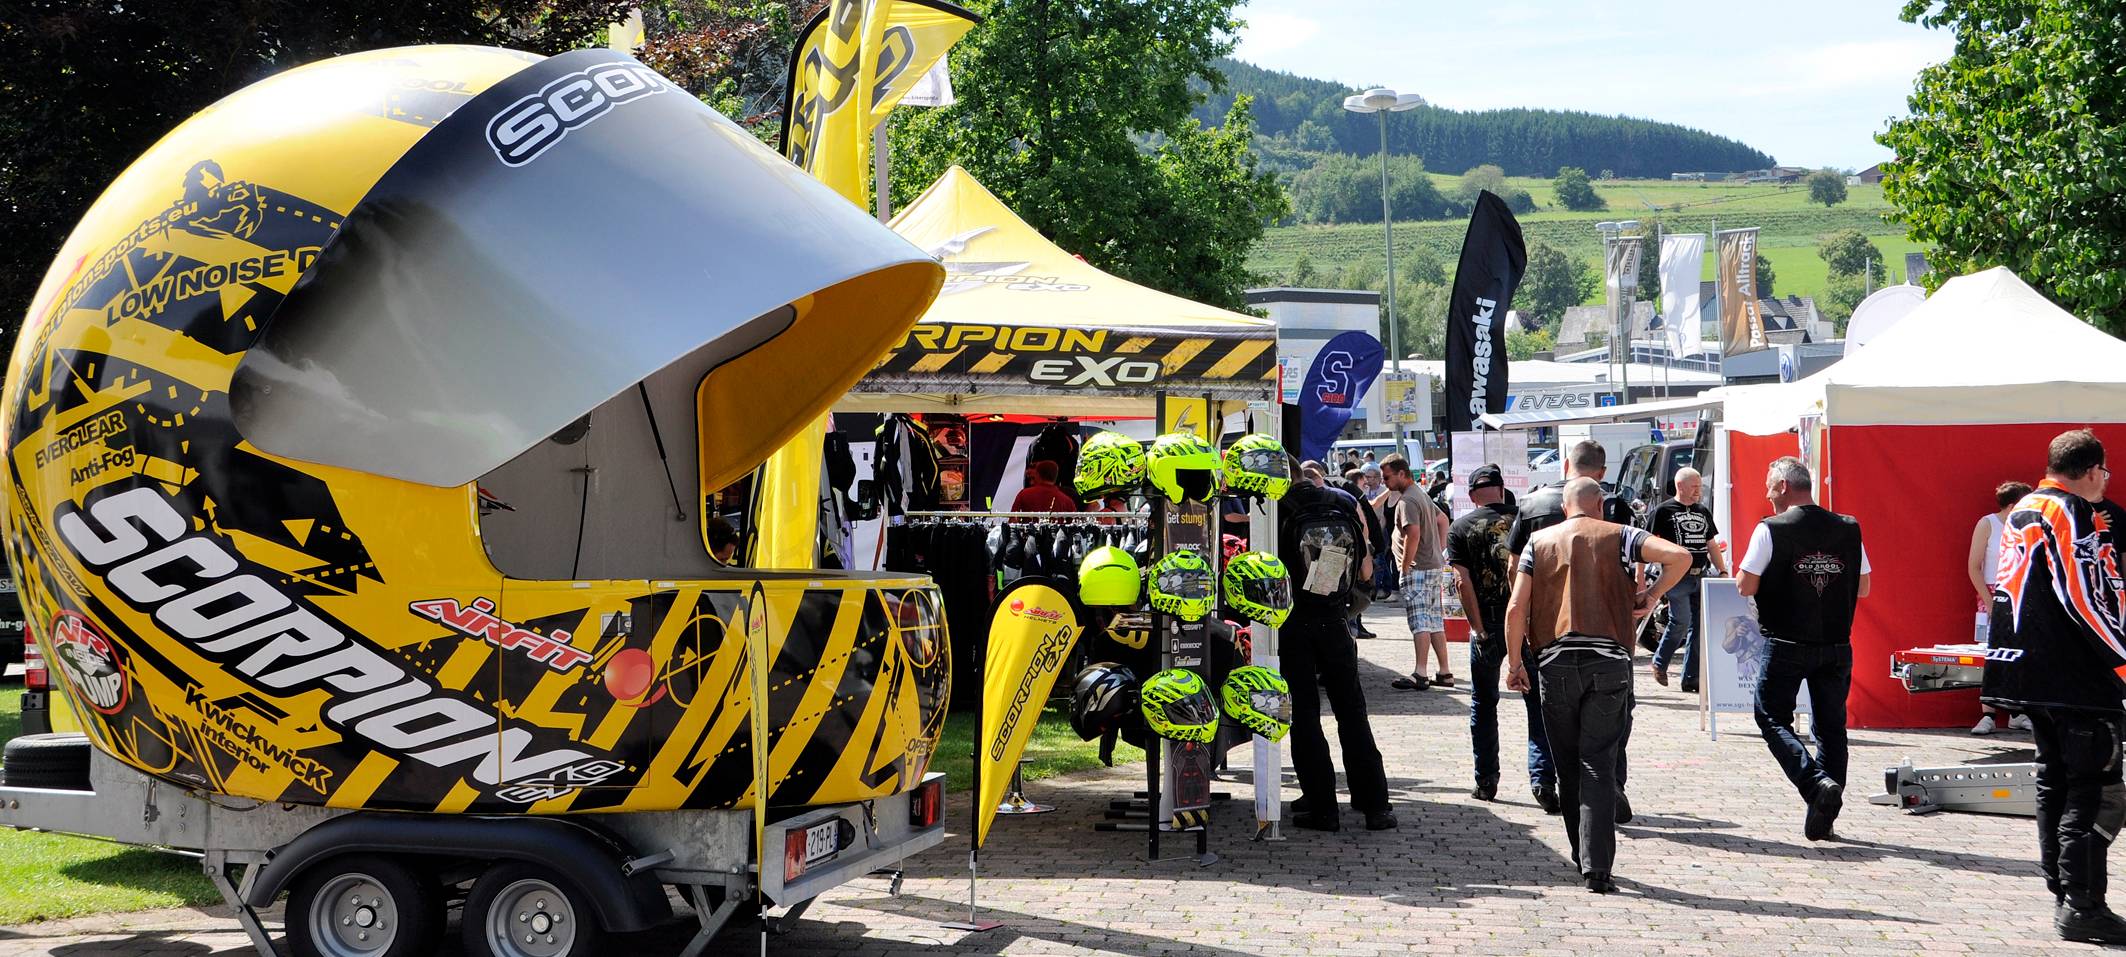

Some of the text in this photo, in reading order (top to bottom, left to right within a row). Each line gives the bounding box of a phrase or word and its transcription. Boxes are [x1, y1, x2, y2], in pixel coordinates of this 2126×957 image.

[107, 276, 176, 327] LOW
[176, 249, 286, 300] NOISE
[1518, 393, 1592, 410] EVERS
[35, 410, 128, 470] EVERCLEAR
[70, 446, 136, 487] Anti-Fog
[1166, 511, 1180, 524] Get
[56, 485, 596, 788] SCORPION
[1044, 624, 1073, 673] EXO
[991, 633, 1054, 762] SCORPION
[200, 720, 271, 775] interior
